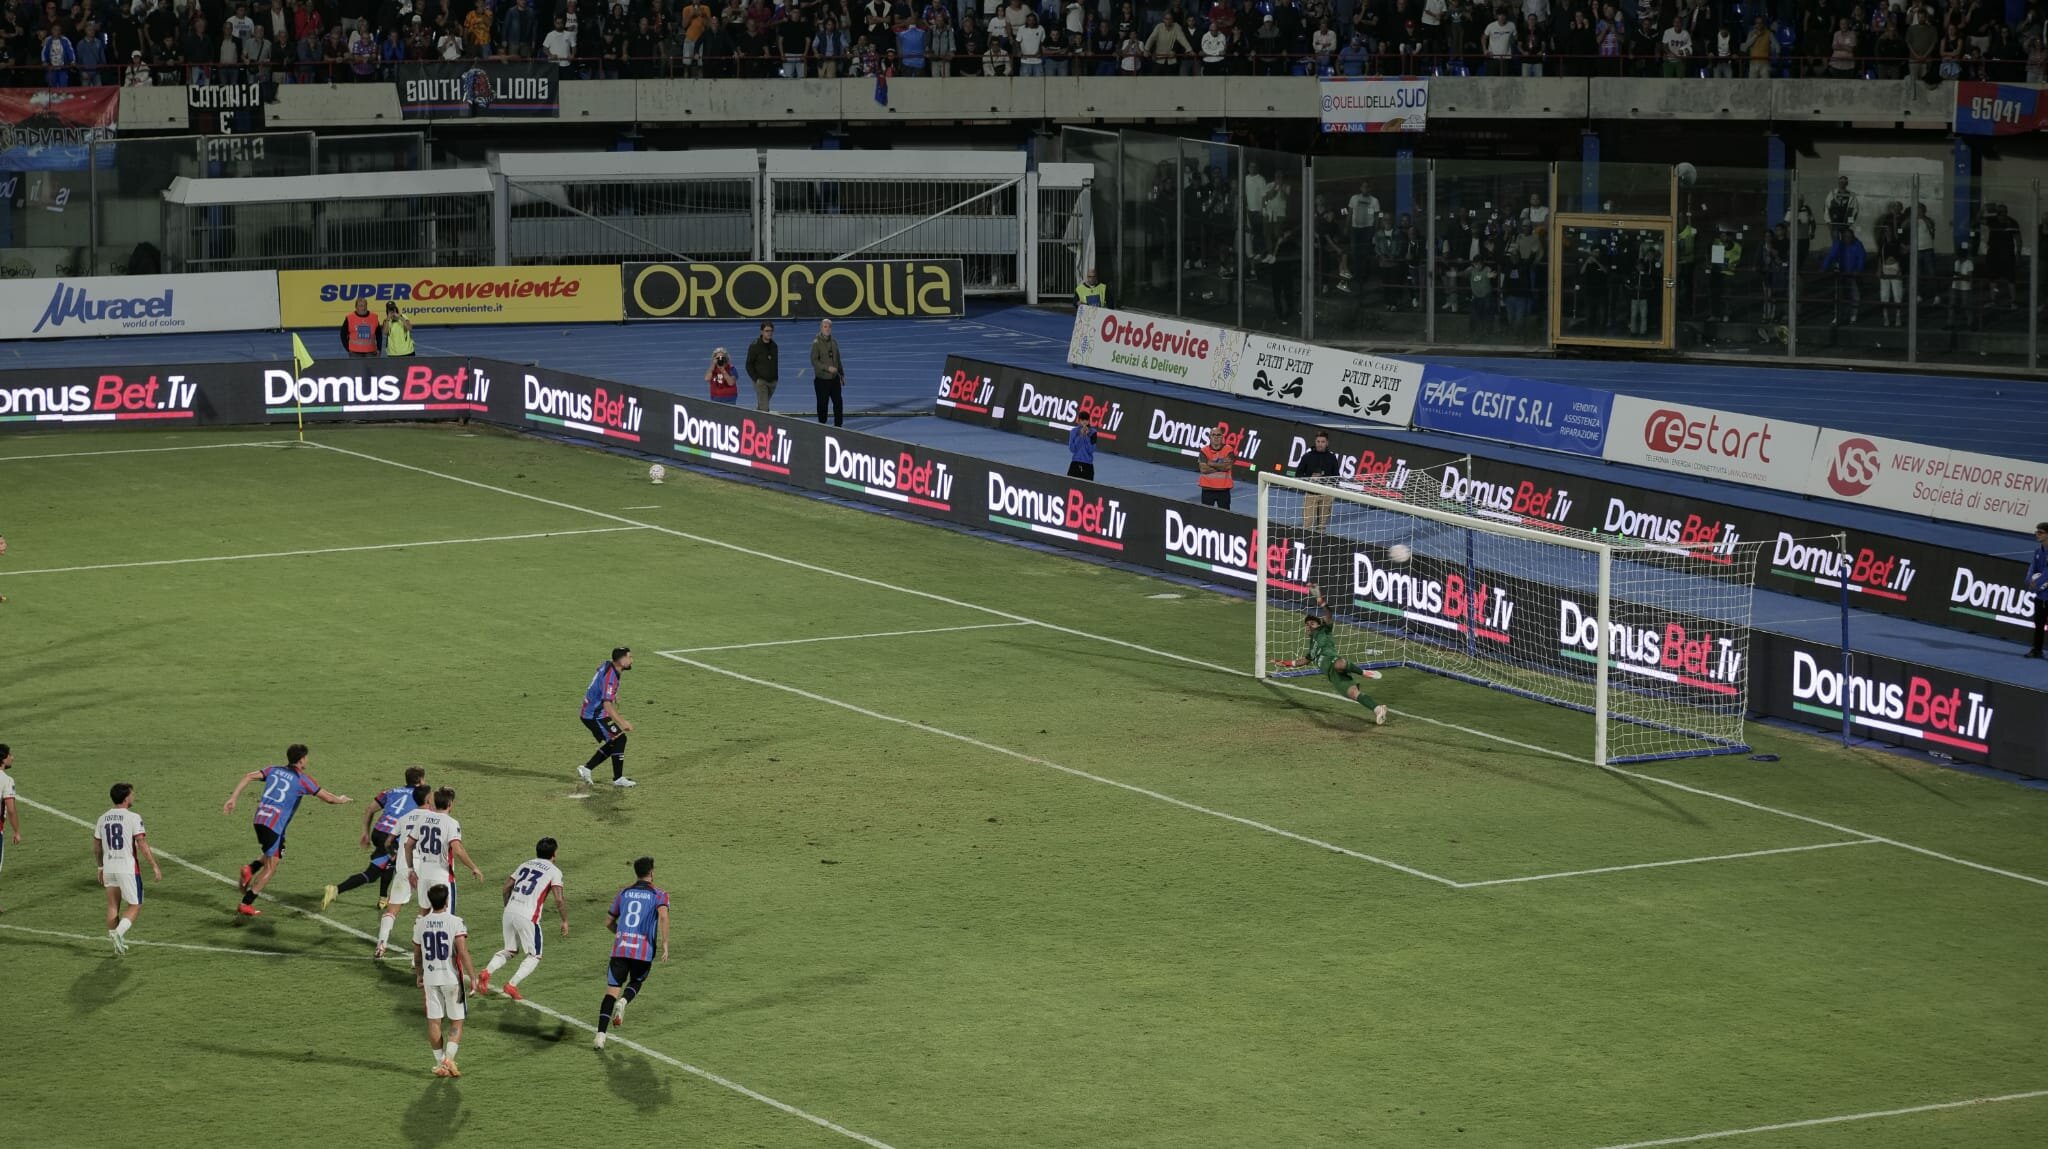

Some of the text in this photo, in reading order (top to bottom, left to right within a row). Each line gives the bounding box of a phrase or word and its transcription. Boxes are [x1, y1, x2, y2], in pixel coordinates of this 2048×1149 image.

[406, 77, 549, 102] SOUTH LIONS
[1971, 96, 2022, 124] 95041
[1324, 122, 1365, 132] CATANIA
[32, 282, 174, 333] Muracel
[402, 303, 503, 315] superconveniente.it
[122, 318, 186, 329] world of colors
[1101, 314, 1209, 360] OrtoService
[1266, 341, 1286, 352] GRAN
[1111, 350, 1189, 378] Servizi & Delivery
[1352, 358, 1373, 369] GRAN
[1424, 381, 1467, 408] FAAC
[1572, 400, 1598, 414] VENDITA
[1471, 390, 1553, 428] CESIT S.R.L
[1563, 414, 1601, 428] ASSISTENZA
[1560, 426, 1600, 441] RIPARAZIONE
[1647, 413, 1771, 463] restart
[1672, 458, 1691, 469] ENERGIA
[1891, 453, 2048, 495] NEW SPLENDOR SERVI
[1913, 481, 2031, 518] Società di servizi
[263, 774, 290, 803] 23
[391, 794, 409, 815] 4
[104, 823, 124, 850] 18
[420, 825, 442, 855] 26
[513, 867, 543, 896] 23
[624, 900, 642, 928] 8
[422, 931, 449, 961] 96
